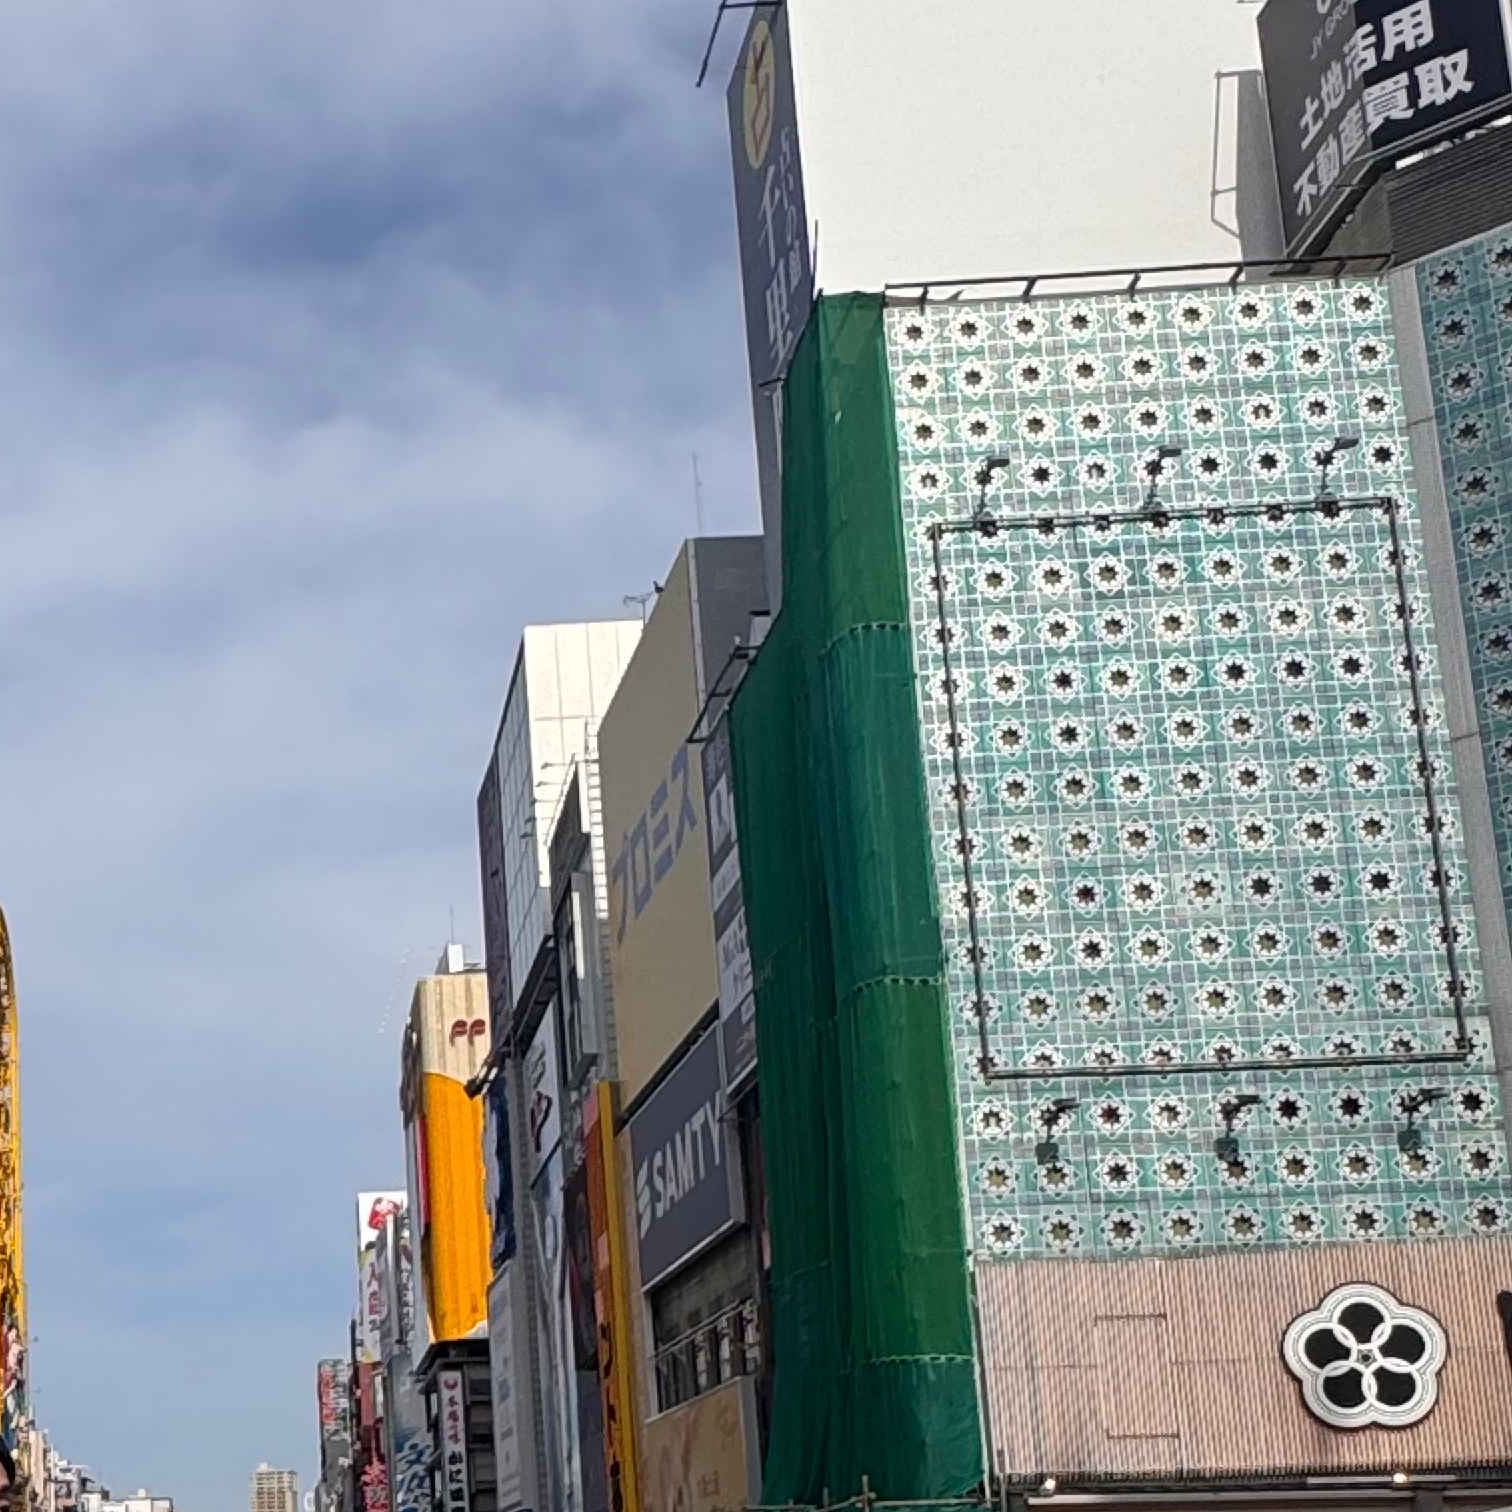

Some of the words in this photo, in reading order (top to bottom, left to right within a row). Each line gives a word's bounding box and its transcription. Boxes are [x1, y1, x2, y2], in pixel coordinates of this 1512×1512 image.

[1293, 49, 1475, 216] 不動産買取
[1299, 0, 1434, 150] 土地活用
[613, 743, 698, 949] プロミス
[652, 1090, 721, 1218] SAMTY
